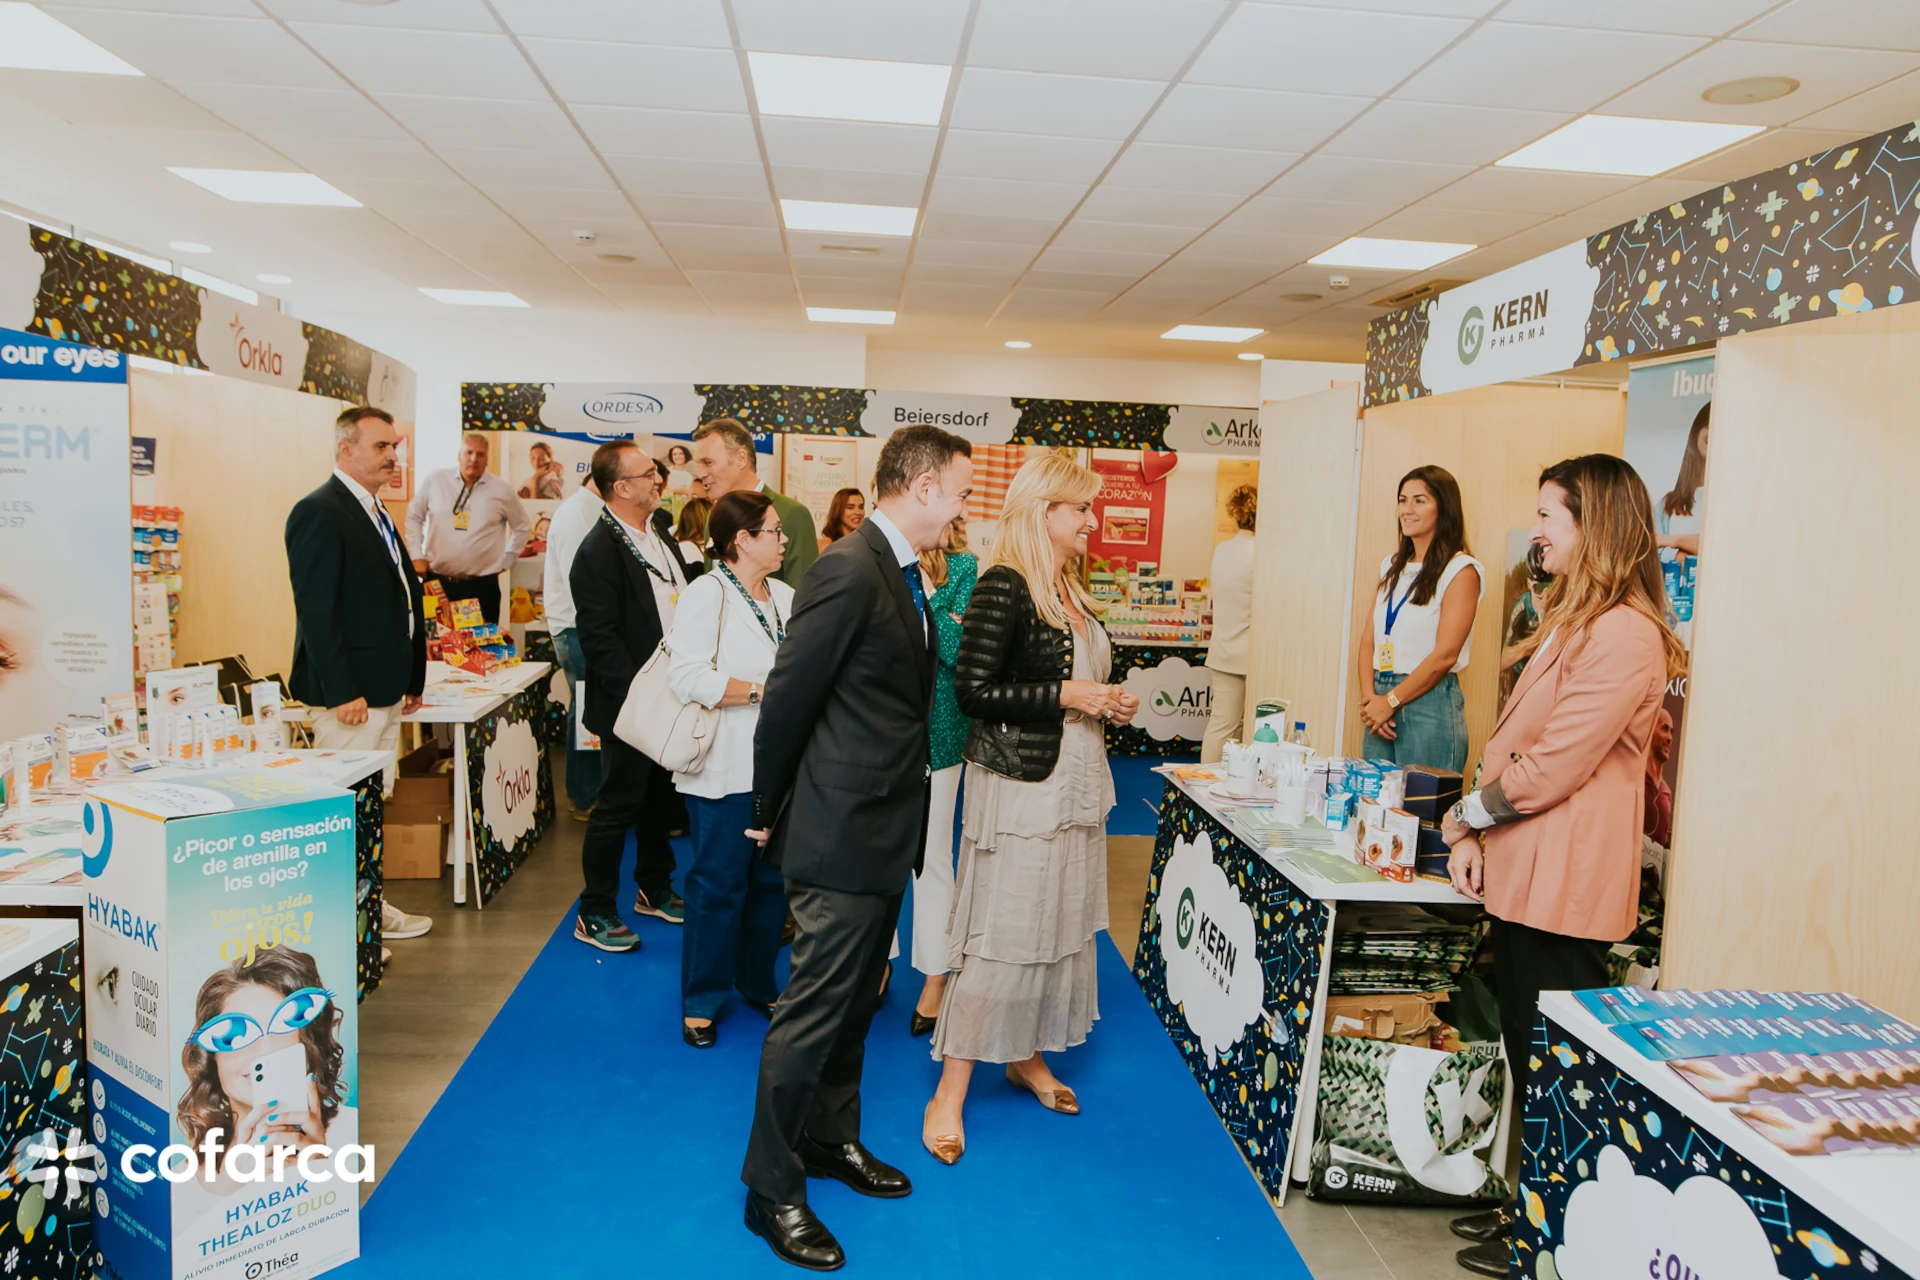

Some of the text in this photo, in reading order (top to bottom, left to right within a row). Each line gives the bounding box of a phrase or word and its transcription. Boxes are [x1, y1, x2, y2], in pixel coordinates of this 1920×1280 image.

[1492, 288, 1549, 332] KERN
[1490, 325, 1545, 350] PHARMA
[1, 344, 120, 374] our eyes
[239, 337, 283, 377] Orkla
[592, 401, 655, 414] ORDESA
[894, 407, 989, 427] Beiersdorf
[1225, 418, 1262, 439] Ark
[504, 765, 531, 814] Orkla
[173, 815, 352, 864] ¿Picor o sensación
[202, 840, 327, 876] de arenilla en
[224, 861, 309, 892] los ojos?
[261, 903, 274, 915] la
[277, 893, 313, 912] vida
[88, 892, 158, 952] HYABAK
[219, 911, 314, 968] ojos!
[1199, 911, 1238, 978] KERN
[131, 970, 159, 999] CUIDADO
[1195, 945, 1231, 997] PHARMA
[134, 991, 158, 1019] OCULAR
[136, 1011, 157, 1037] DIARIO
[1353, 1172, 1397, 1190] KERN
[226, 1180, 309, 1224] HYABAK
[198, 1190, 337, 1256] THEALOZ DUO
[184, 1207, 350, 1280] ALIVIO INMEDIATO DE LARGA DURACIÓN
[265, 1252, 299, 1273] Théa
